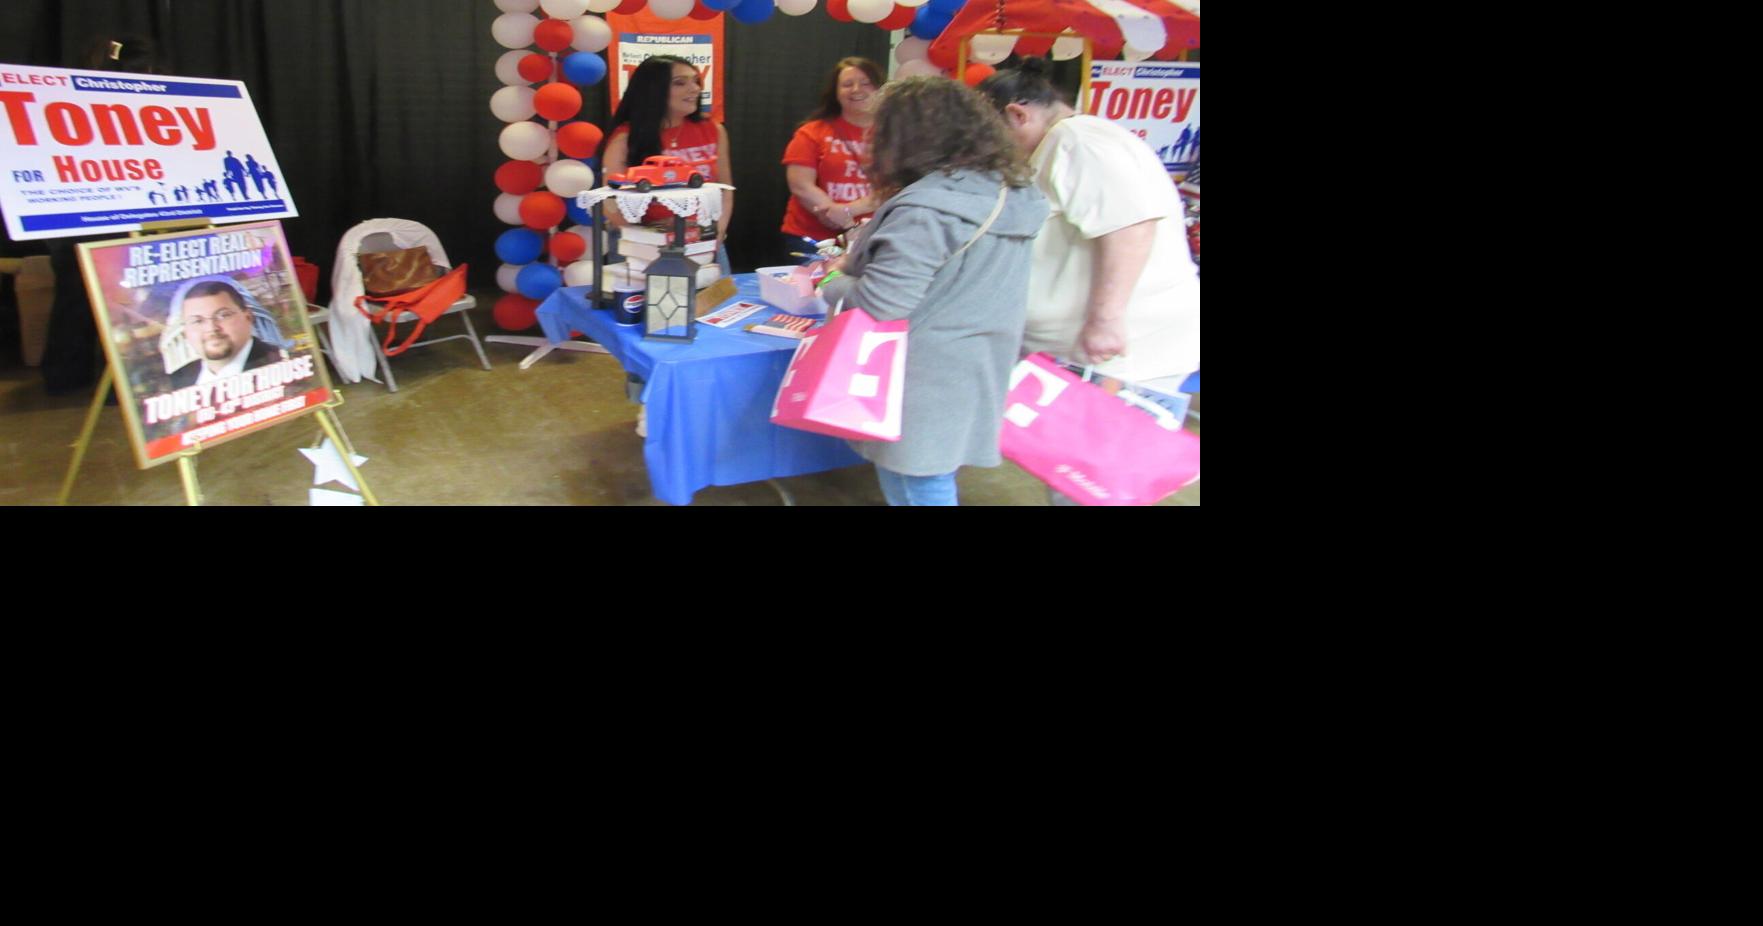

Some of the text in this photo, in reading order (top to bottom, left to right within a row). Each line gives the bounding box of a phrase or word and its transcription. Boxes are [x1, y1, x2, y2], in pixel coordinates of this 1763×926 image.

[637, 35, 694, 43] REPUBLICAN
[2, 73, 168, 93] ELECT Christopher
[1089, 81, 1198, 123] Toney
[0, 91, 216, 151] Toney
[12, 155, 165, 183] FOR House
[130, 233, 247, 266] RE-ELECT REAL
[123, 248, 262, 288] REPRESENTATION
[145, 384, 214, 424] TONEY
[214, 373, 256, 404] FOR
[252, 355, 315, 393] HOUSE
